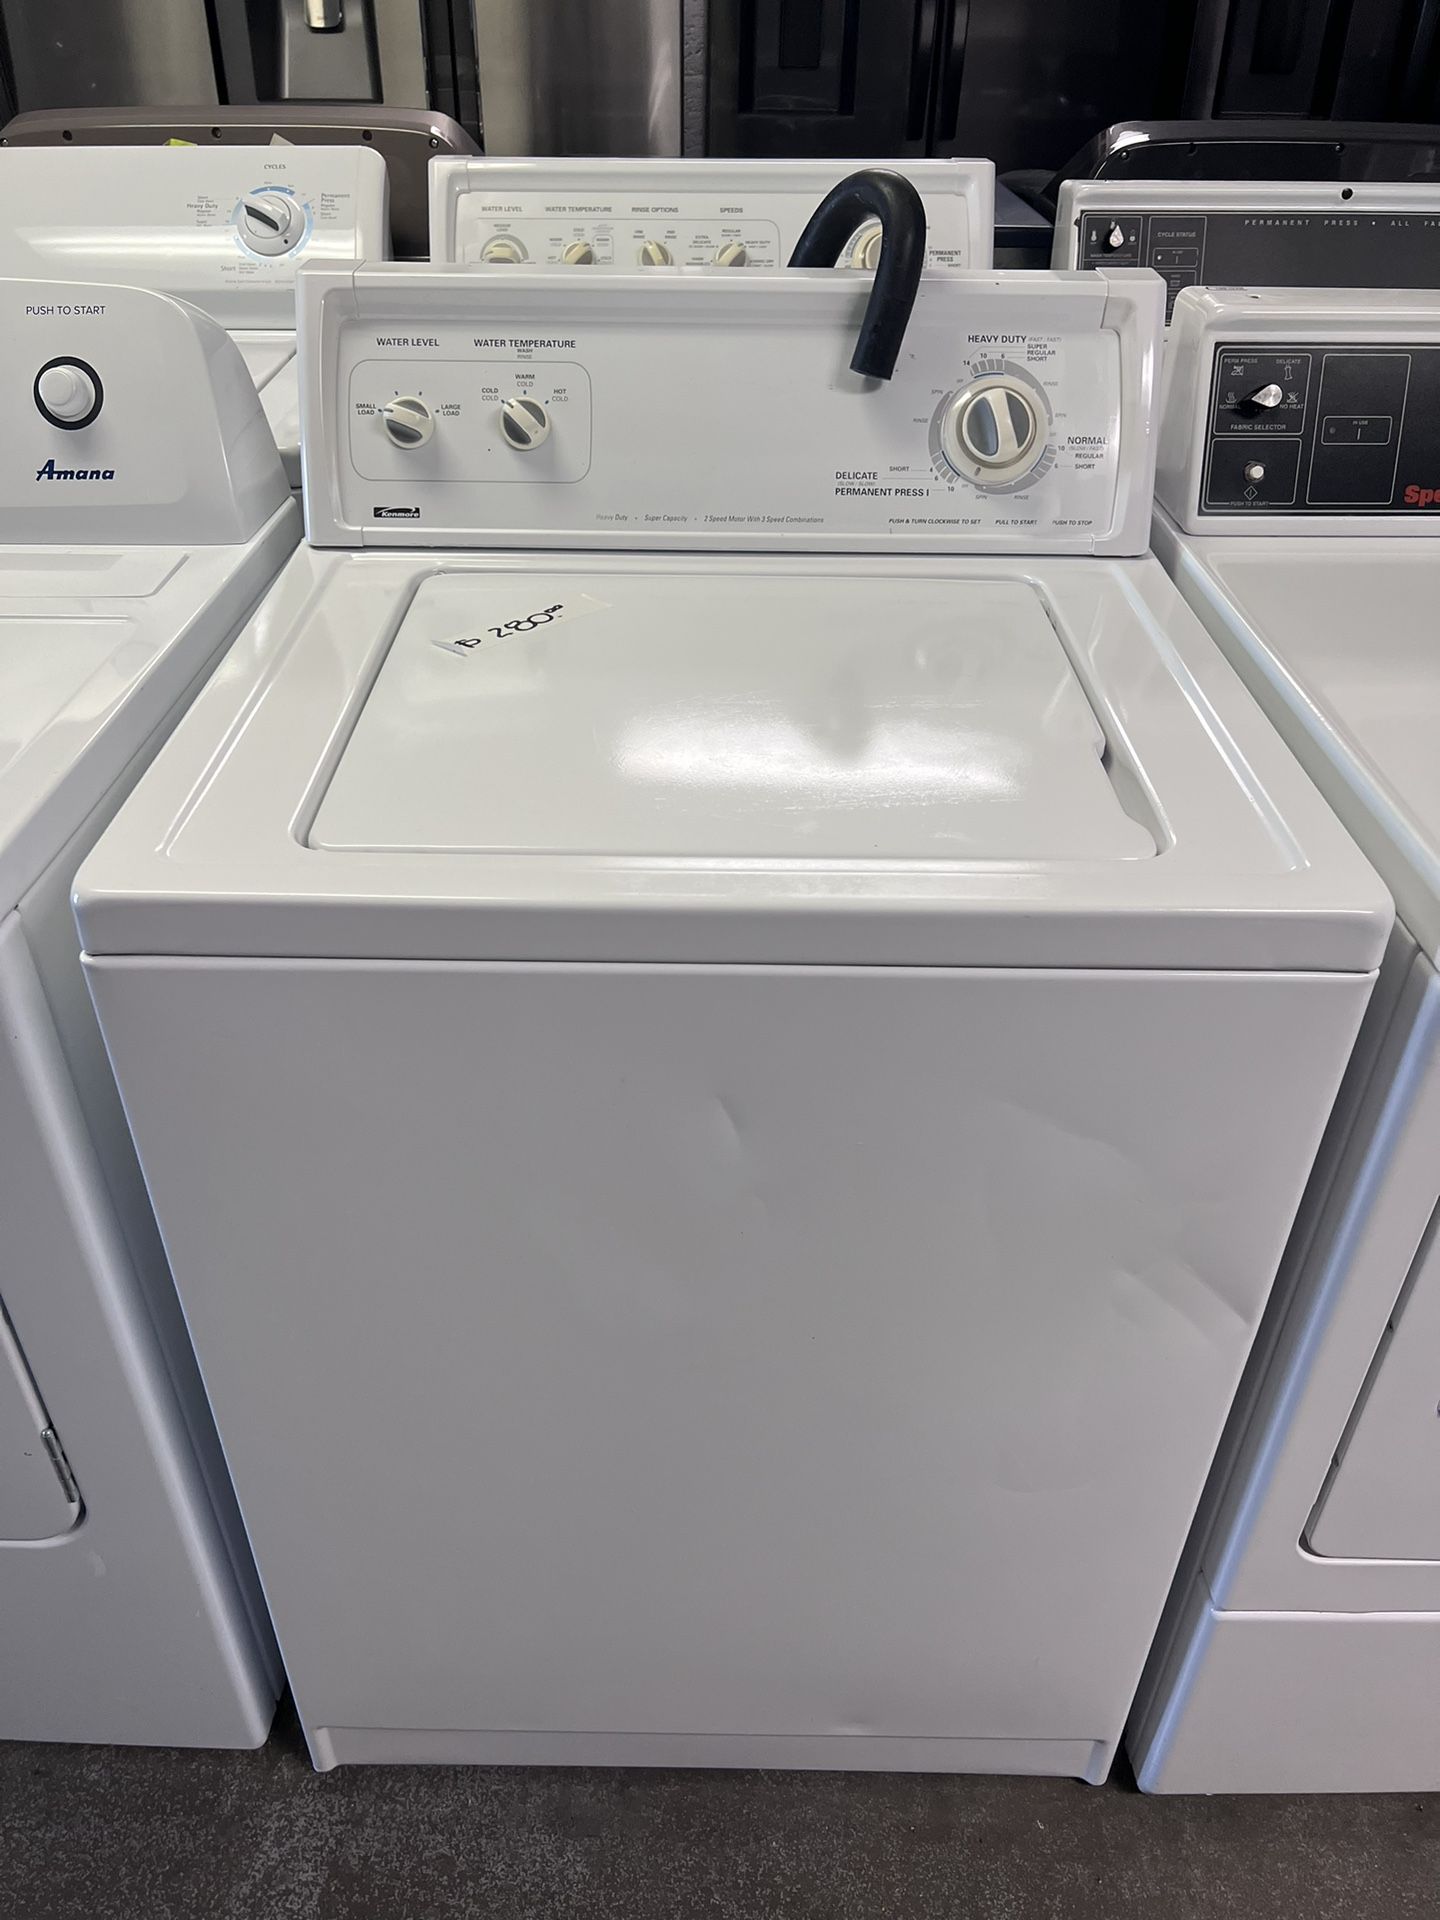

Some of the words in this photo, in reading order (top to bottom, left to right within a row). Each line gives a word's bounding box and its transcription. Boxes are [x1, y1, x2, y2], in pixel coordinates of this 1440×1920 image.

[26, 306, 54, 315] PUSH
[57, 306, 71, 315] TO
[74, 306, 106, 315] START
[376, 338, 409, 346] WATER
[412, 338, 440, 346] LEVEL
[1001, 335, 1026, 343] DUTY
[474, 339, 506, 347] WATER
[509, 340, 576, 348] TEMPERATURE
[36, 459, 115, 481] Amana
[835, 488, 892, 496] PERMANENT
[663, 514, 688, 522] Capacity
